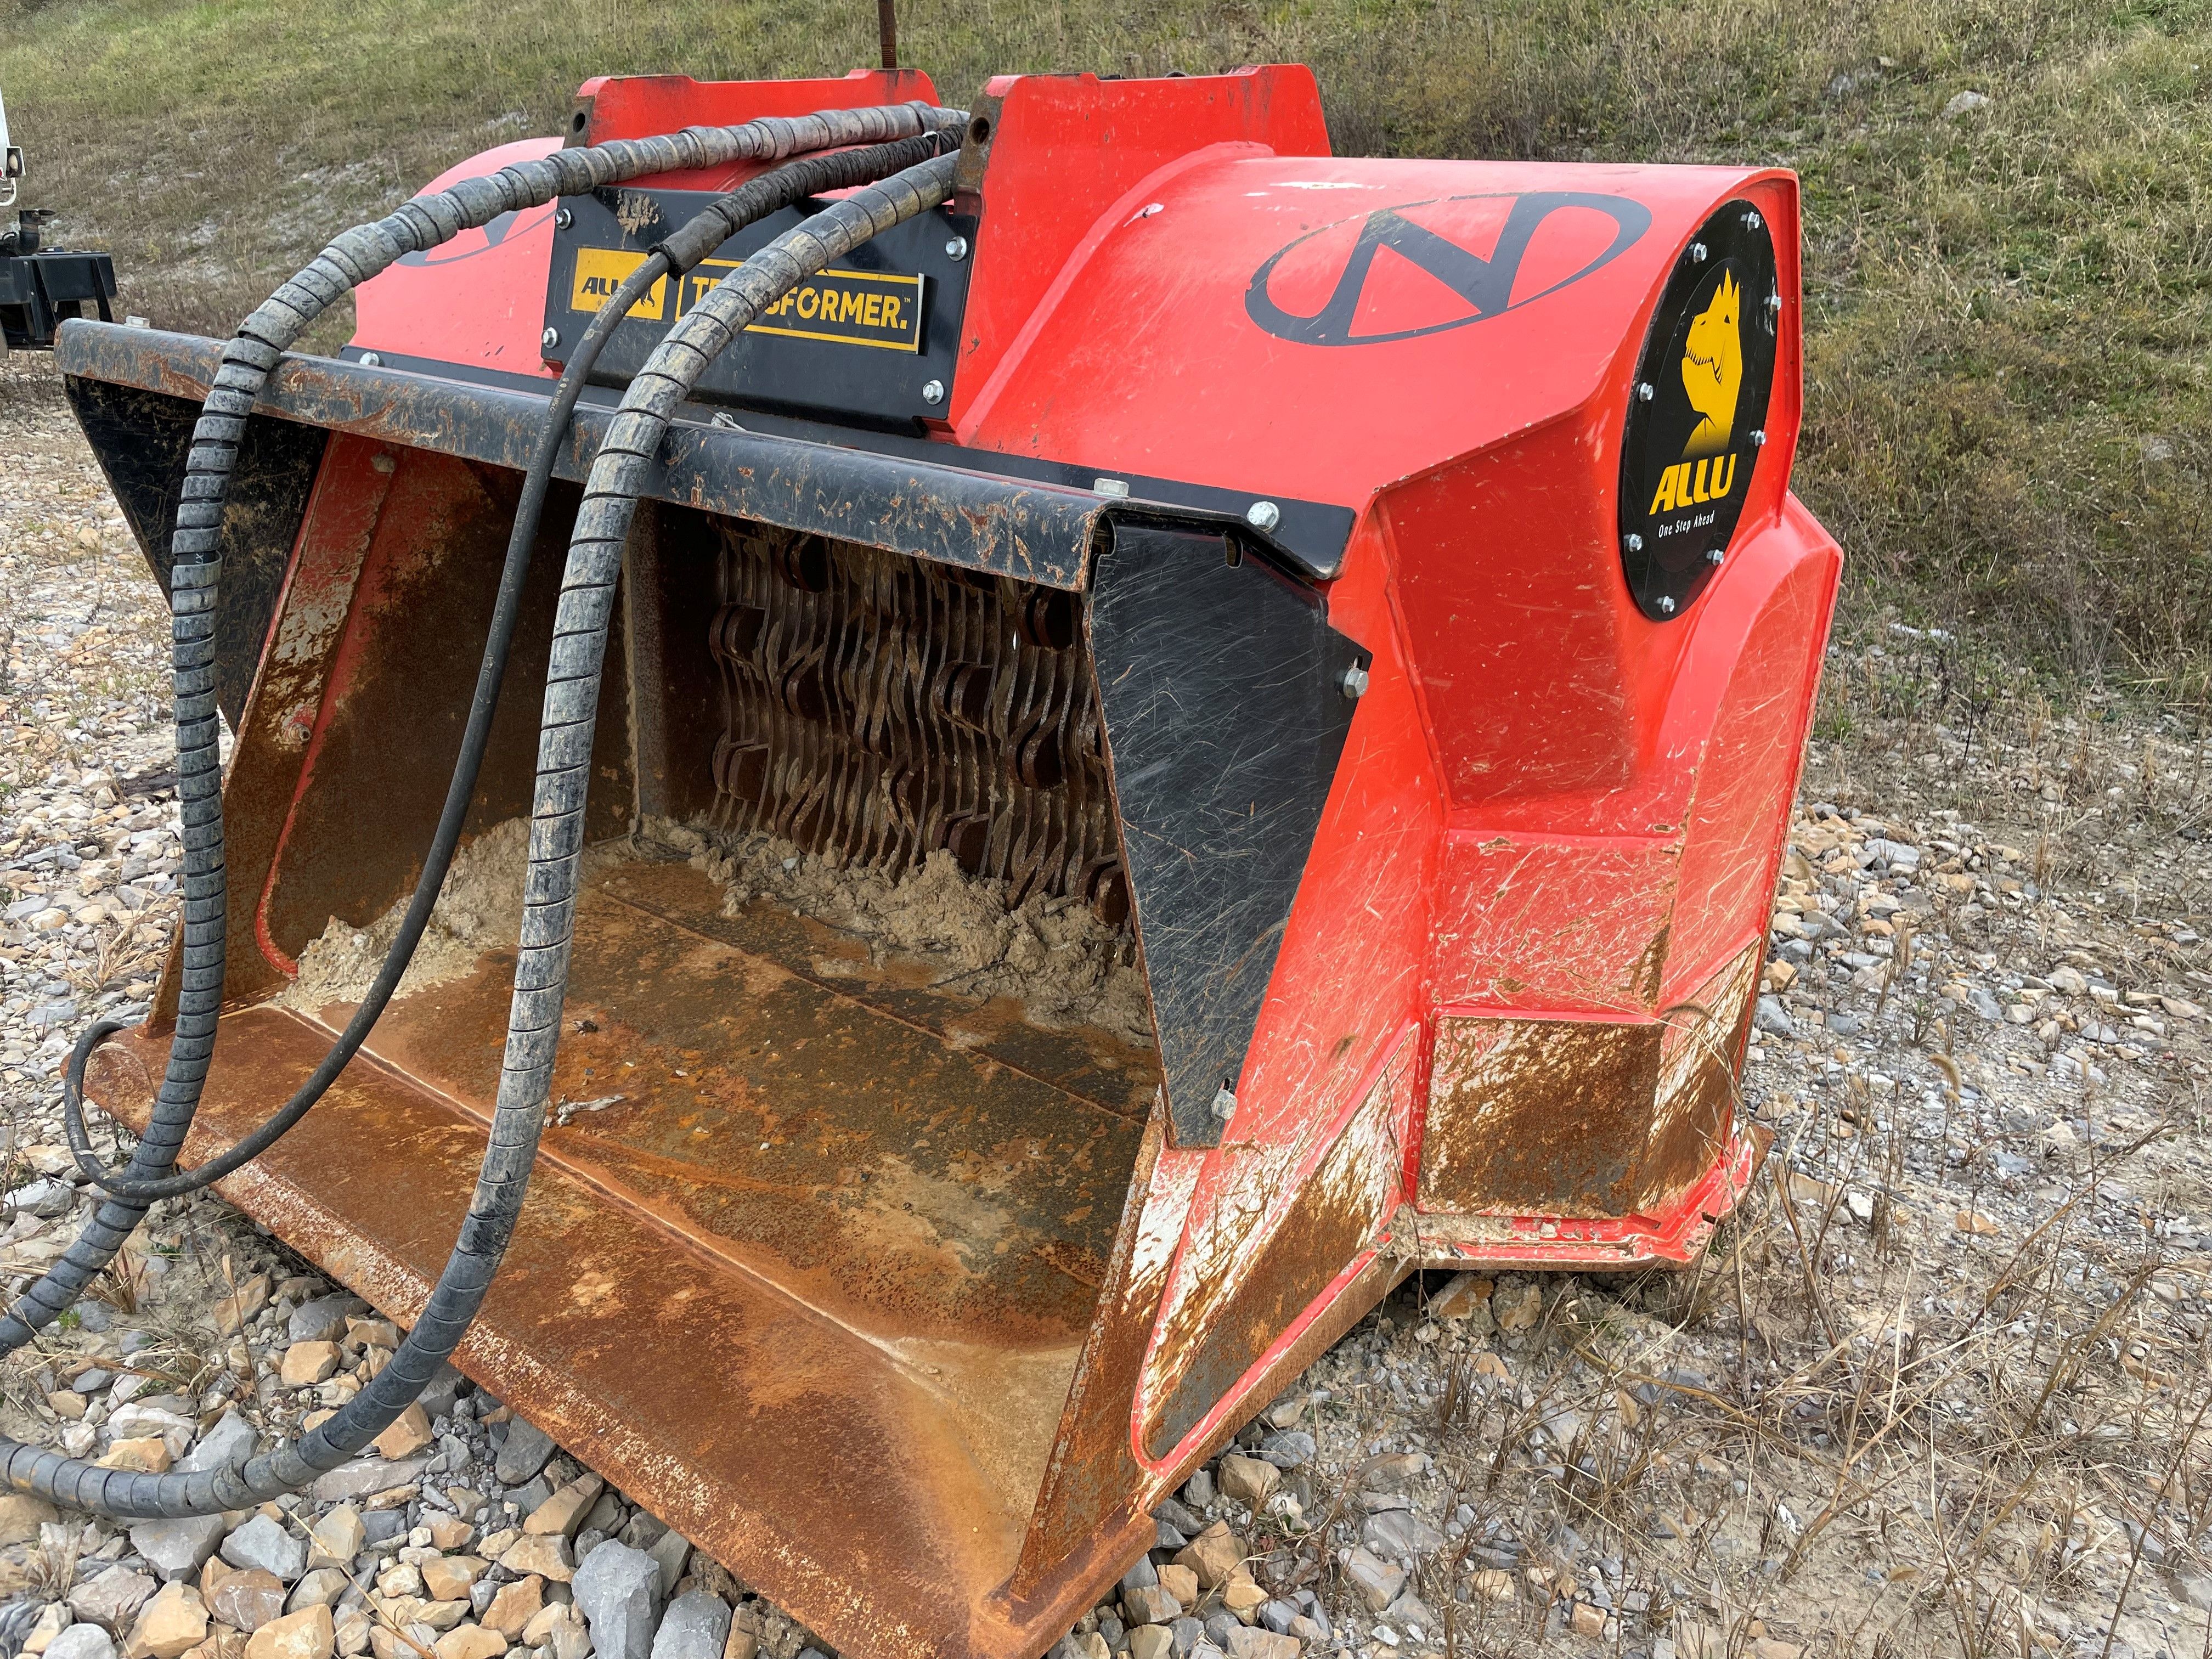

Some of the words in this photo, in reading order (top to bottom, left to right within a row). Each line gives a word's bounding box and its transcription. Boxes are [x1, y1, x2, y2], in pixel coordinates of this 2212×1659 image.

[581, 276, 619, 296] ALL
[692, 276, 907, 330] TFORMER.
[1649, 453, 1736, 516] ALLU
[1658, 524, 1673, 538] One
[1675, 520, 1691, 534] Step
[1693, 510, 1715, 528] Ahead
